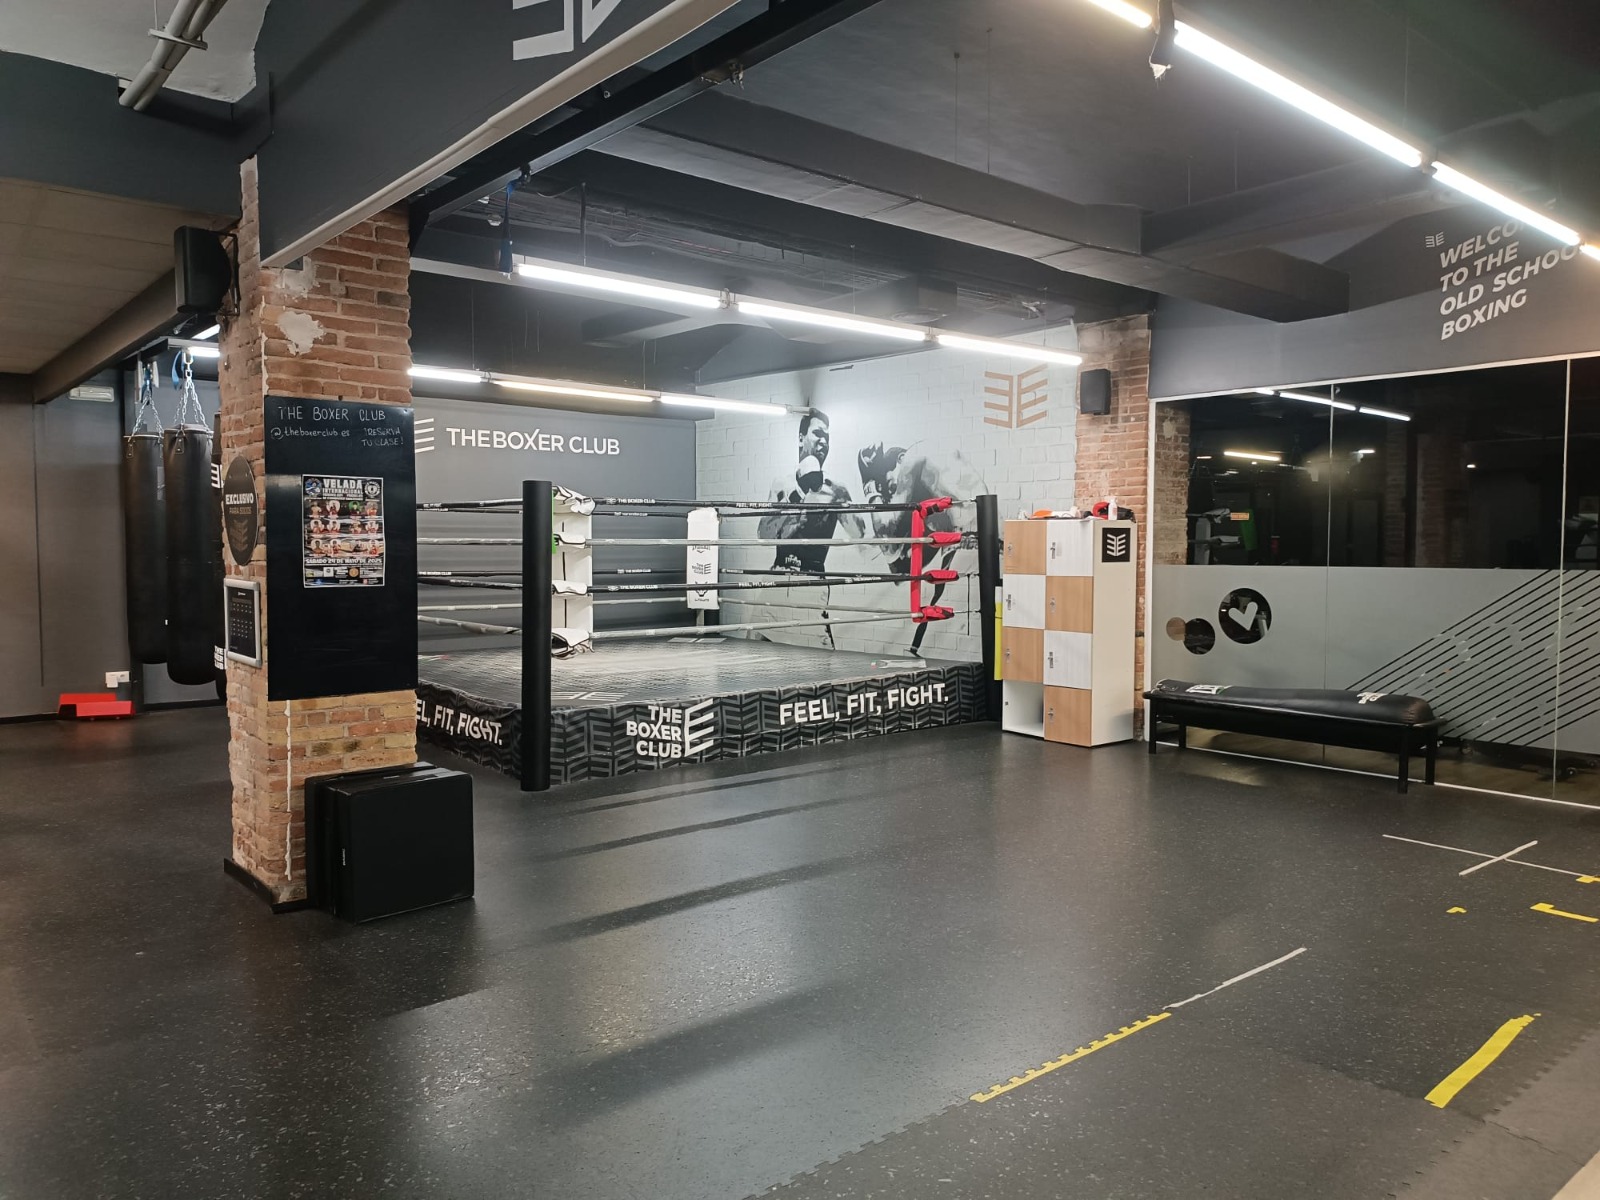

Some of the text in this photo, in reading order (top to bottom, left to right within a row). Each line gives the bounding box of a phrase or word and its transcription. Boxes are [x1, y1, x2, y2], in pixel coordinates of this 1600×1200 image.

[1440, 241, 1519, 292] TO THE
[1440, 283, 1484, 315] OLD
[1440, 288, 1527, 340] BOXING
[278, 405, 386, 421] THE BOXER CLUB
[568, 435, 620, 455] CLUB
[323, 478, 363, 489] VELADA
[225, 493, 254, 505] EXCLUSIVO
[648, 705, 682, 724] THE
[779, 683, 949, 725] FEEL, FIT, FIGHT.
[433, 704, 454, 736] FIT,
[457, 712, 503, 746] FIGHT.
[626, 719, 682, 741] BOXER
[636, 740, 682, 758] CLUB
